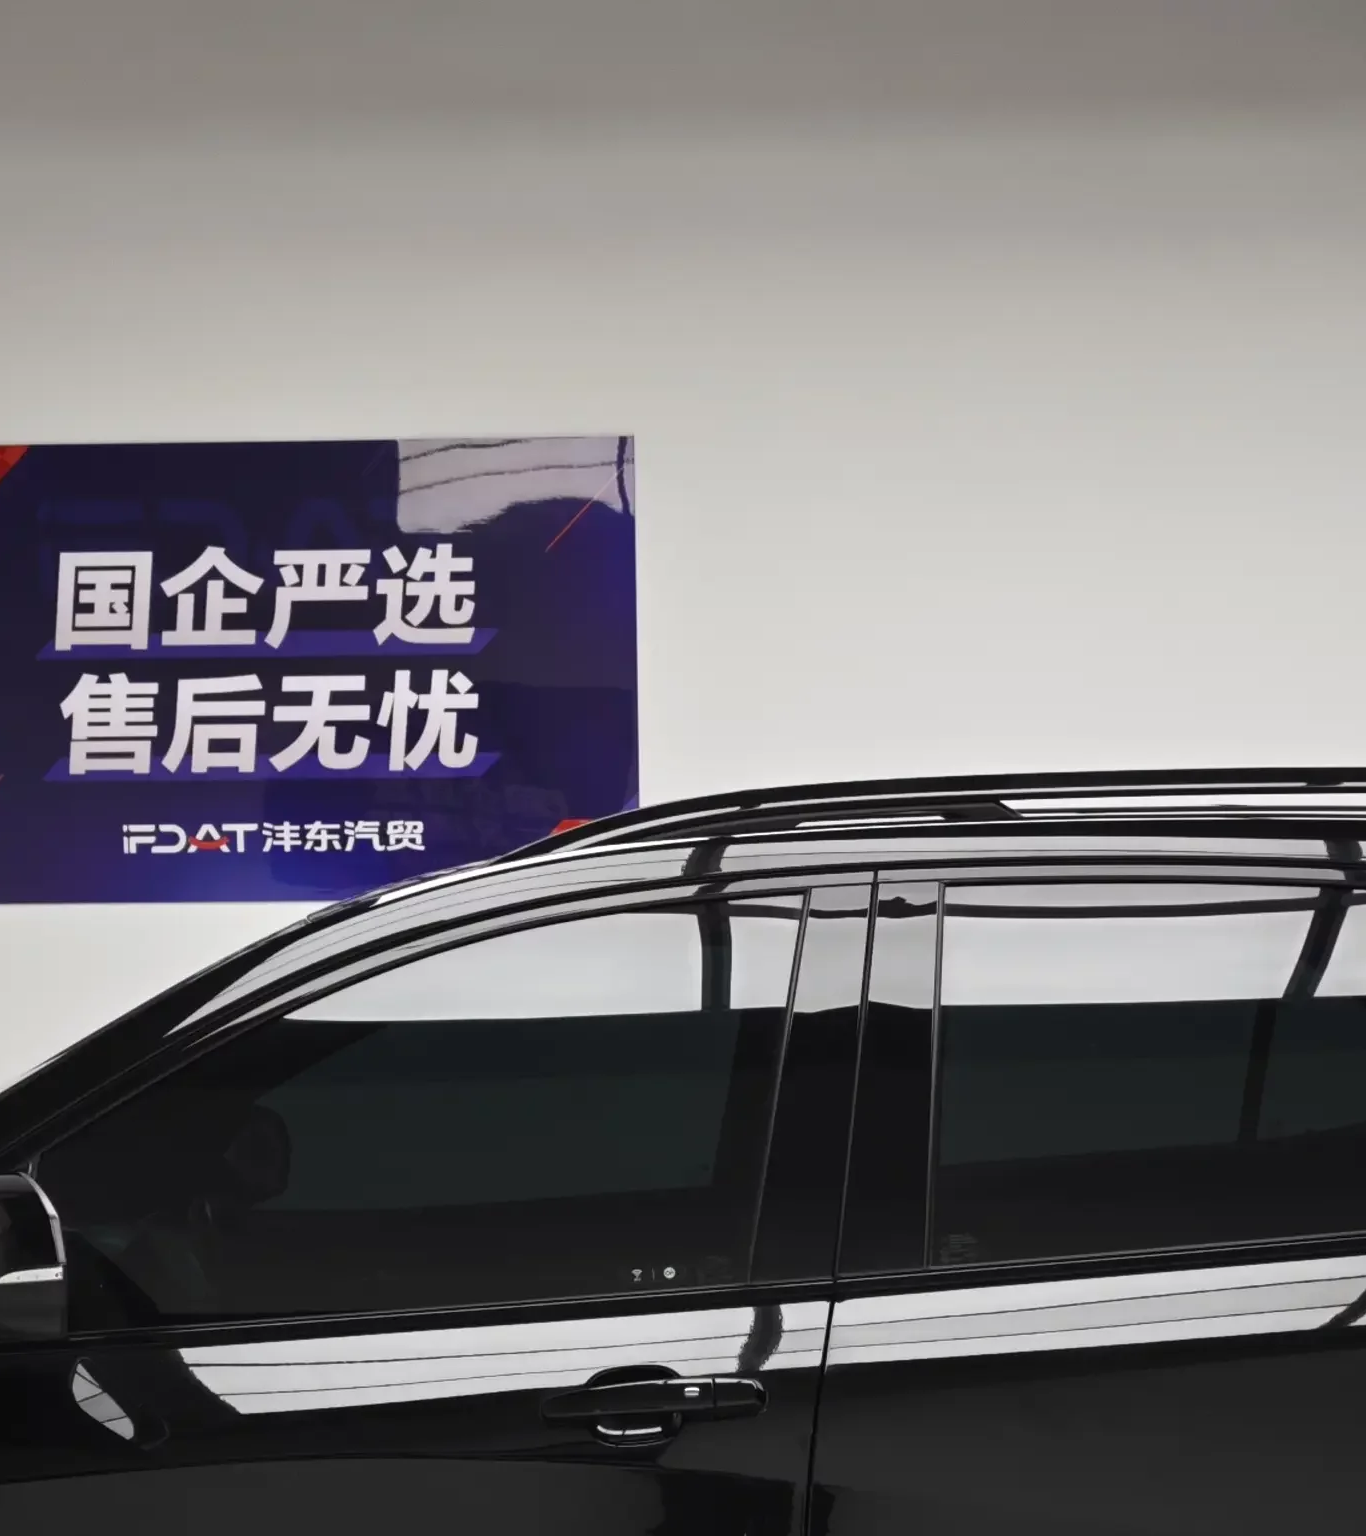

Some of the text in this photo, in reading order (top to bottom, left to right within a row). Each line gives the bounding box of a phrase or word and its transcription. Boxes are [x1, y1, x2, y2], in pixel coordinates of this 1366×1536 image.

[55, 544, 477, 652] 国企严选
[59, 670, 479, 776] 售后无忧
[262, 820, 426, 853] 沣东汽贸
